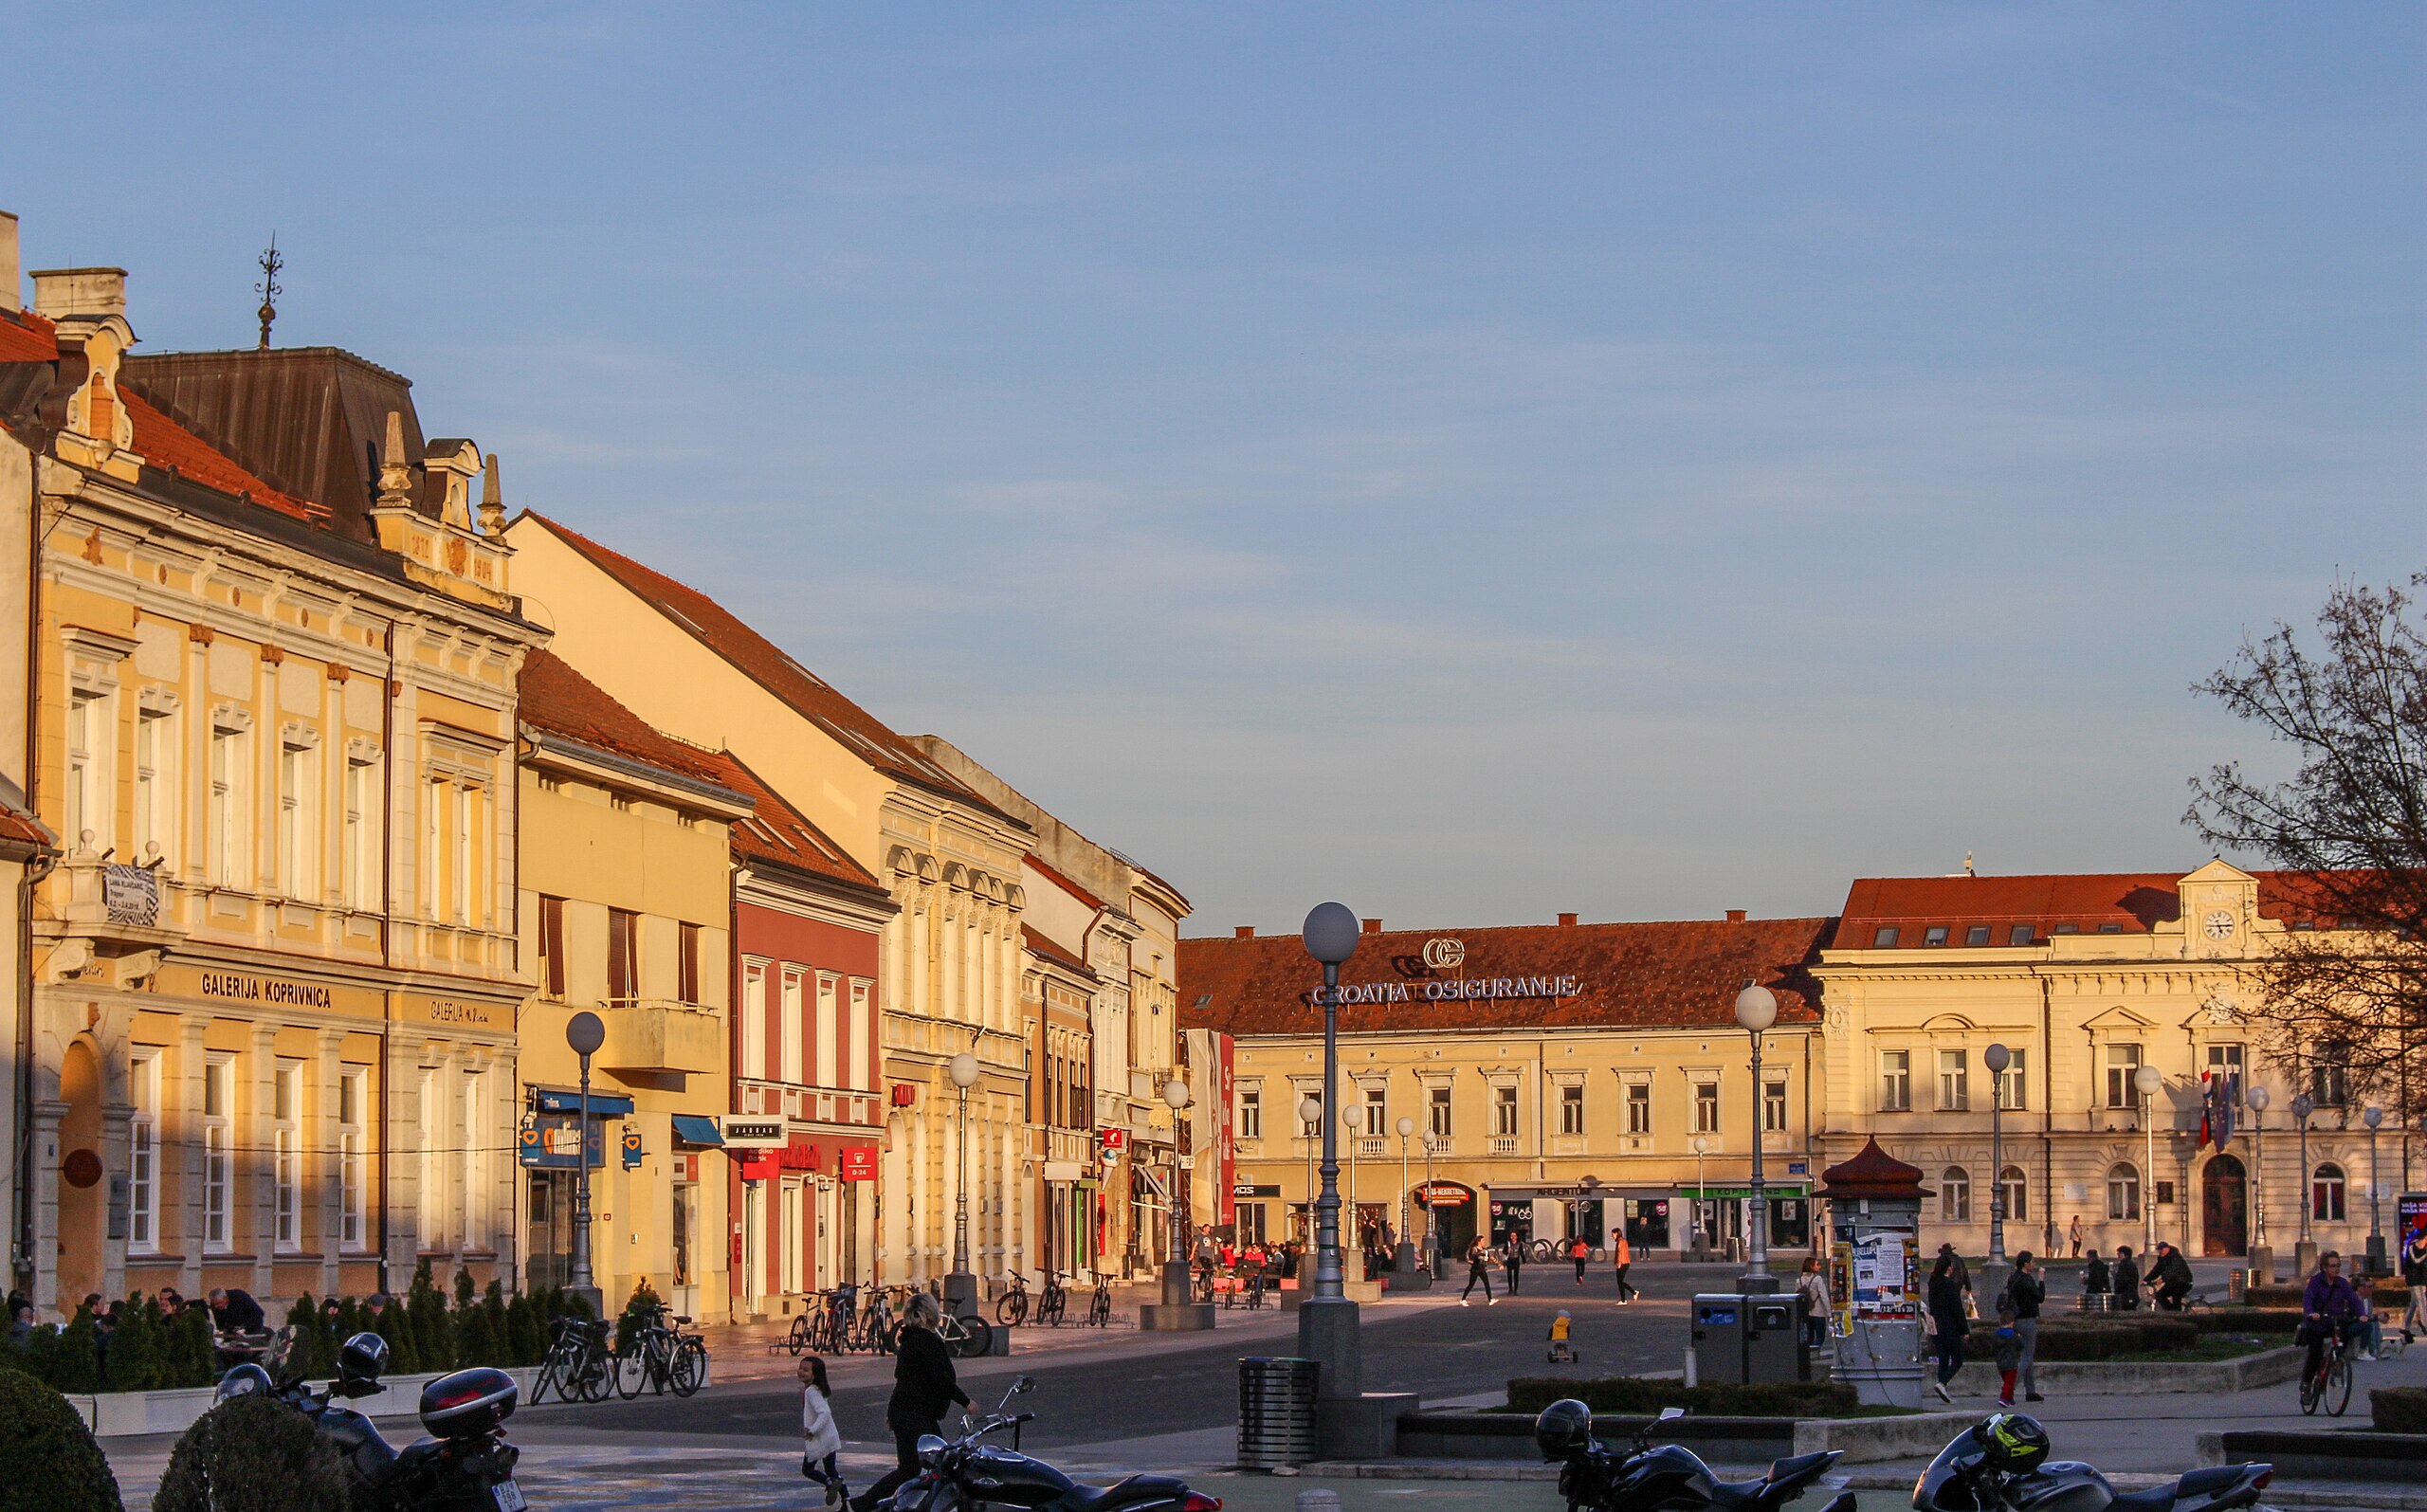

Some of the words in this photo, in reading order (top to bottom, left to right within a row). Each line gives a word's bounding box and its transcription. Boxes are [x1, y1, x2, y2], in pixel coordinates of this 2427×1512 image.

[202, 973, 259, 1000] GALERIJA
[265, 980, 331, 1009] KOPRIVNICA
[1311, 981, 1410, 1005] CROATIA
[1425, 975, 1577, 1000] OSIGURANJE
